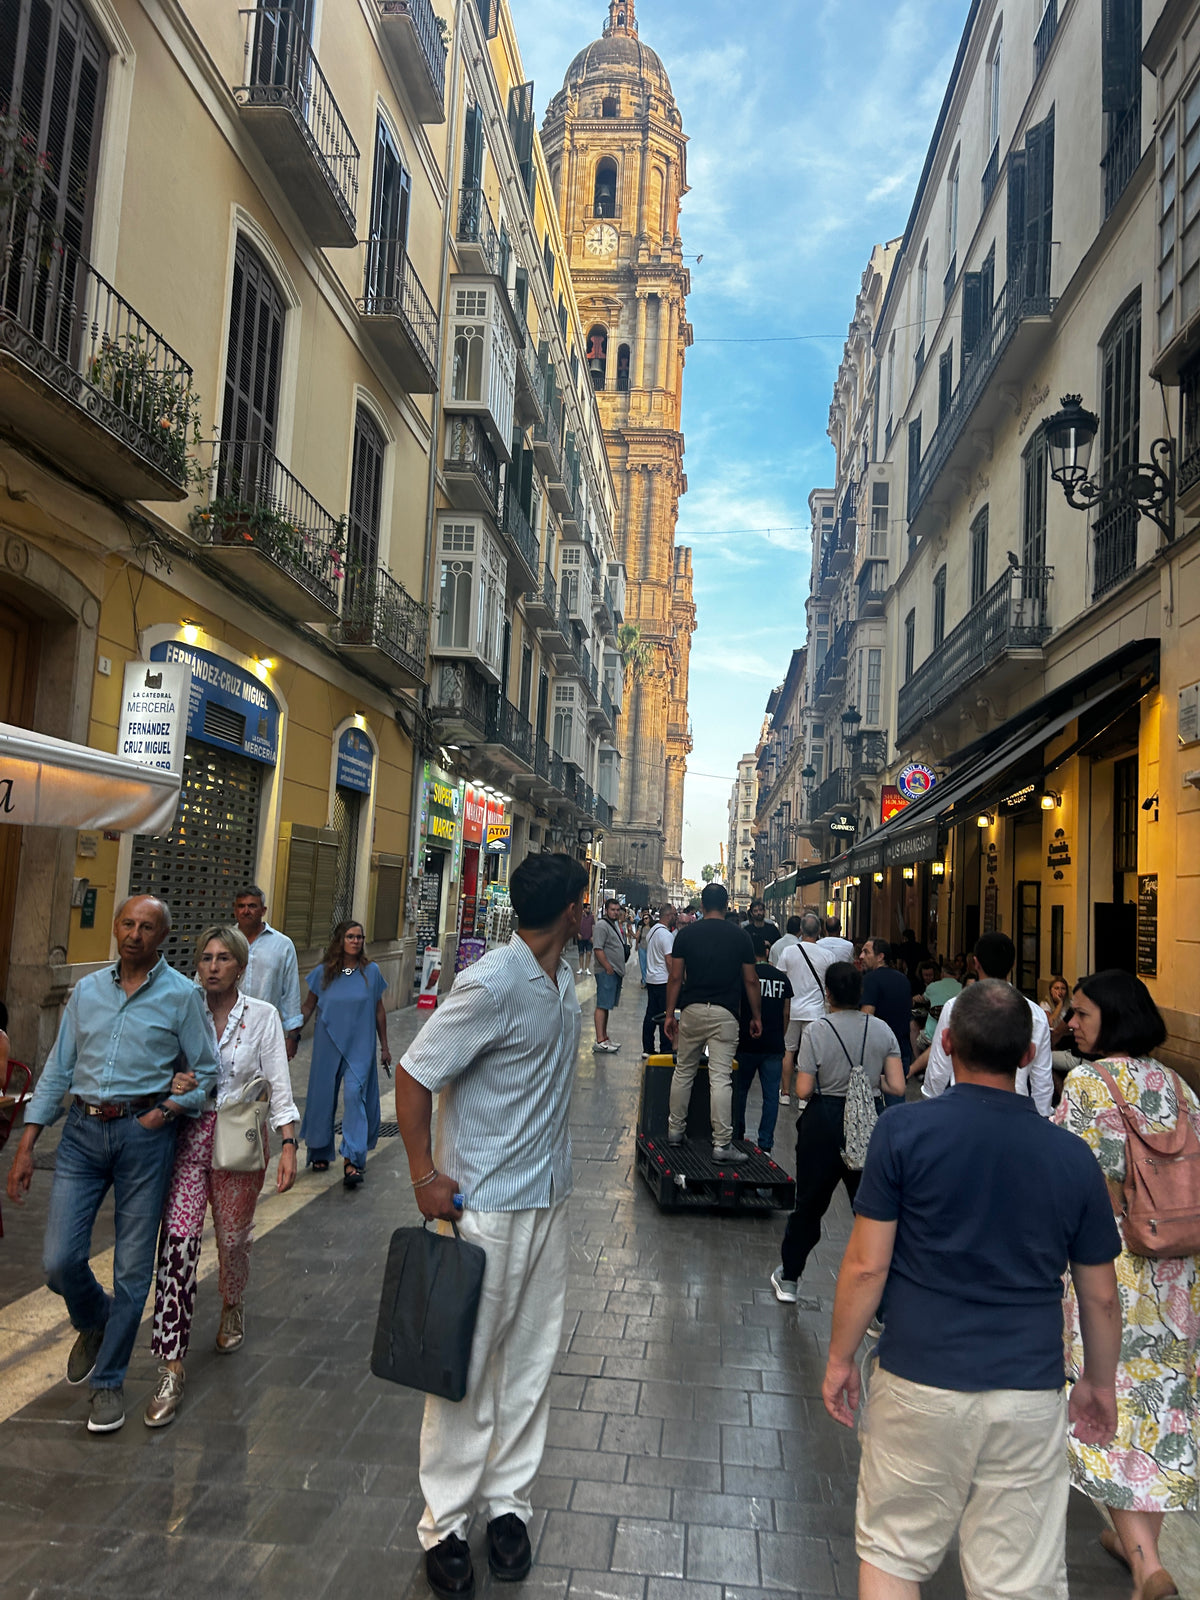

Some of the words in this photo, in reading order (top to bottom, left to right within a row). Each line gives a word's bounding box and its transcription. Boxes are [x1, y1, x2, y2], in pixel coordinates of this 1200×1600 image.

[242, 681, 269, 711] MIGUEL
[127, 700, 175, 713] MERCERÍA
[128, 720, 170, 736] FERNÁNDEZ
[123, 740, 143, 754] CRUZ
[144, 741, 171, 754] MIGUEL
[244, 740, 277, 763] MERCERÍA
[900, 764, 936, 780] PAULANER
[433, 782, 453, 808] SUPER
[432, 815, 456, 840] MARKET
[488, 827, 509, 836] ATM
[830, 823, 855, 832] GUINNESS
[759, 978, 785, 999] TAFF
